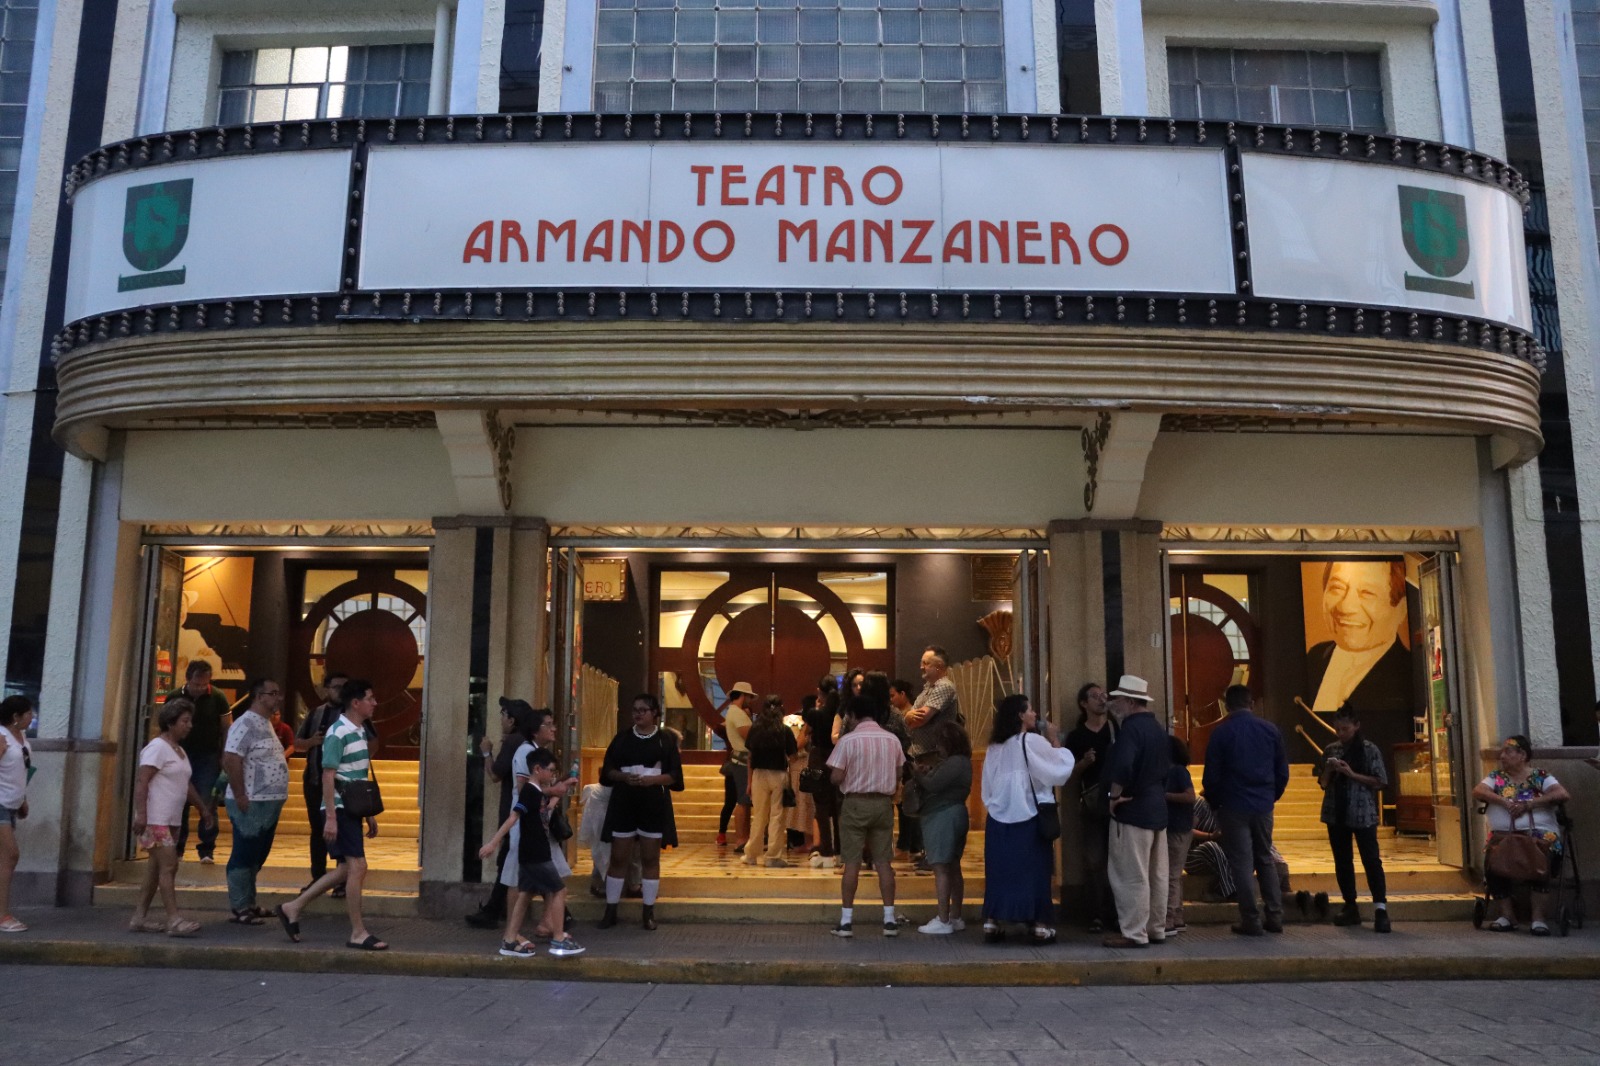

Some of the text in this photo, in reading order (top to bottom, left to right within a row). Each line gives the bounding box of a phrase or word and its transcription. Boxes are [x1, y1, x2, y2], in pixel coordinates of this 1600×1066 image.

[691, 165, 903, 206] TEATRO
[463, 219, 1130, 266] ARMANDO MANZANERO
